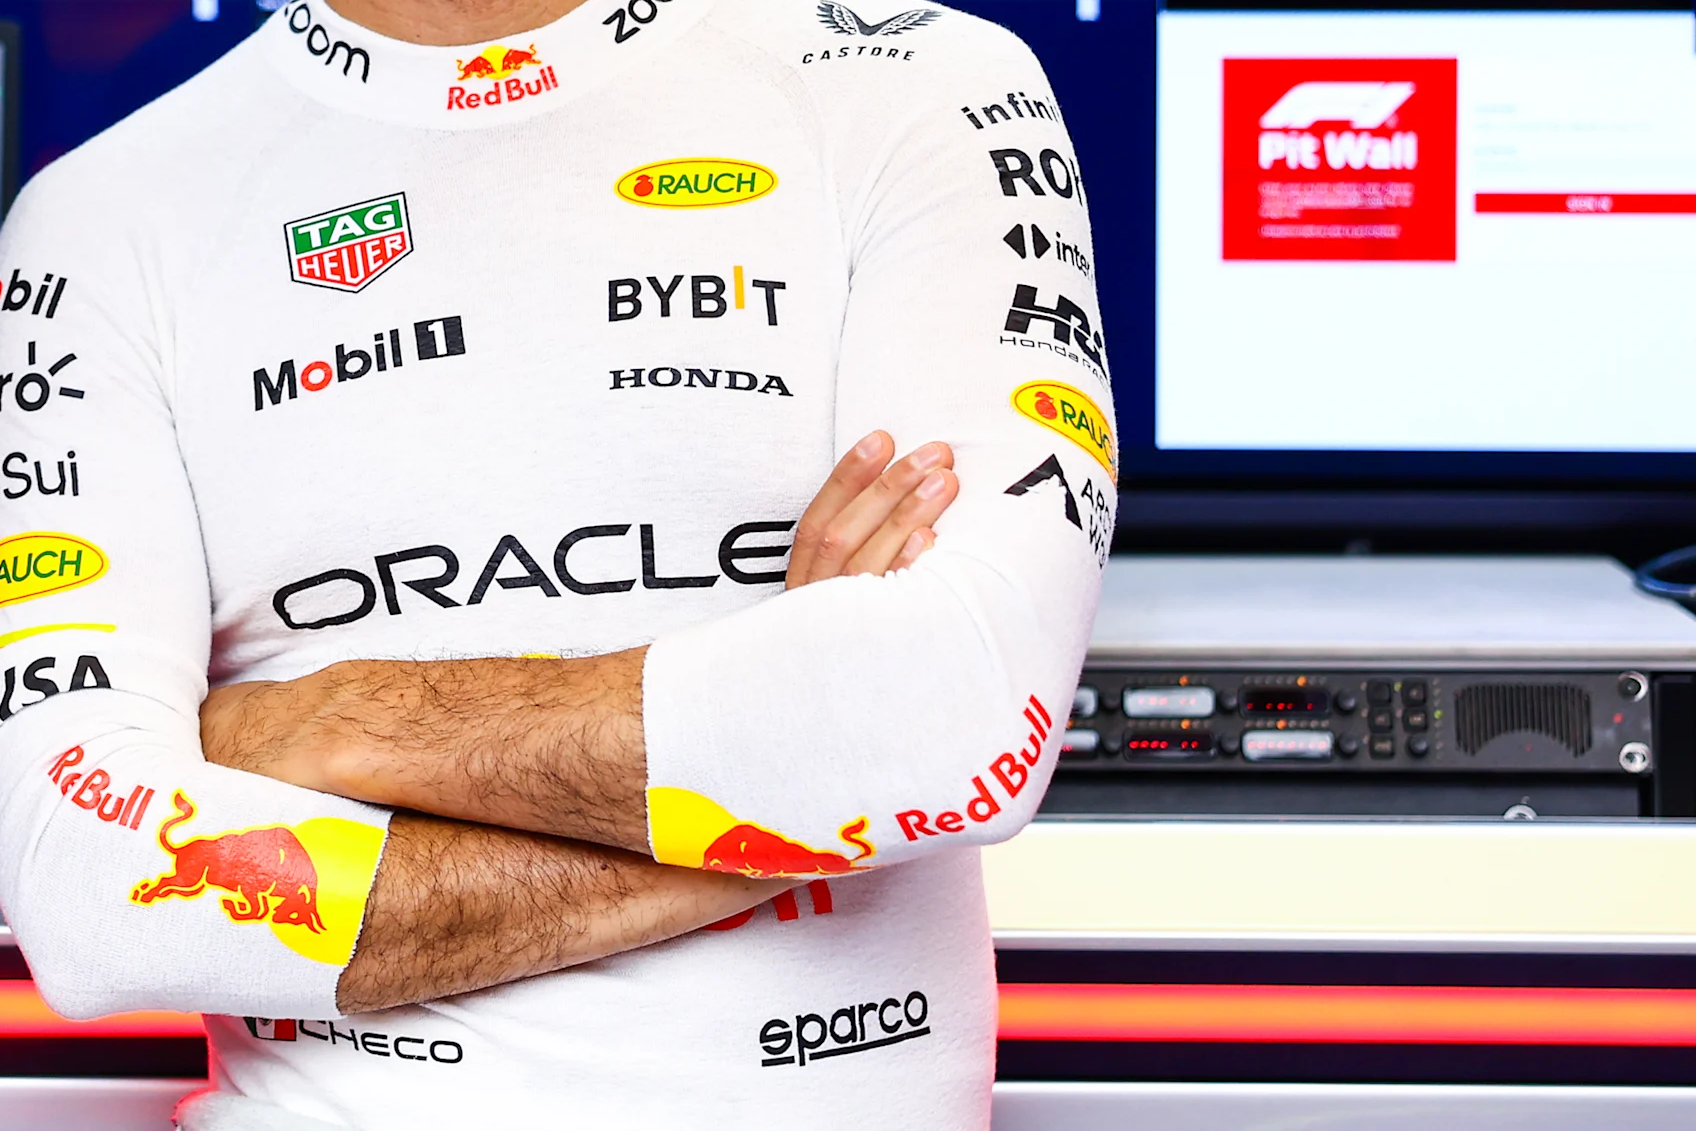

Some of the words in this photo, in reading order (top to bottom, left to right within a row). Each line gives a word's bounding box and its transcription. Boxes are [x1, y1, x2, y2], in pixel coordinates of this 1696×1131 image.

[802, 46, 915, 64] CASTORE
[447, 82, 501, 110] Red
[505, 66, 559, 102] Bull
[1259, 131, 1320, 169] Pit
[1324, 131, 1417, 169] Wall
[657, 172, 756, 195] RAUCH
[298, 204, 397, 249] TAG
[300, 235, 403, 281] HEUER
[608, 266, 787, 326] BYBIT
[254, 328, 402, 411] Mobil
[1000, 336, 1078, 363] Honda
[609, 367, 793, 397] HONDA
[1060, 399, 1116, 465] RAUC
[2, 450, 79, 500] Sui
[273, 520, 796, 630] ORACLE
[895, 776, 1002, 841] Red
[989, 694, 1053, 799] Bull
[71, 768, 155, 831] Bull
[299, 1019, 463, 1064] CHECO
[759, 990, 929, 1066] sparco
